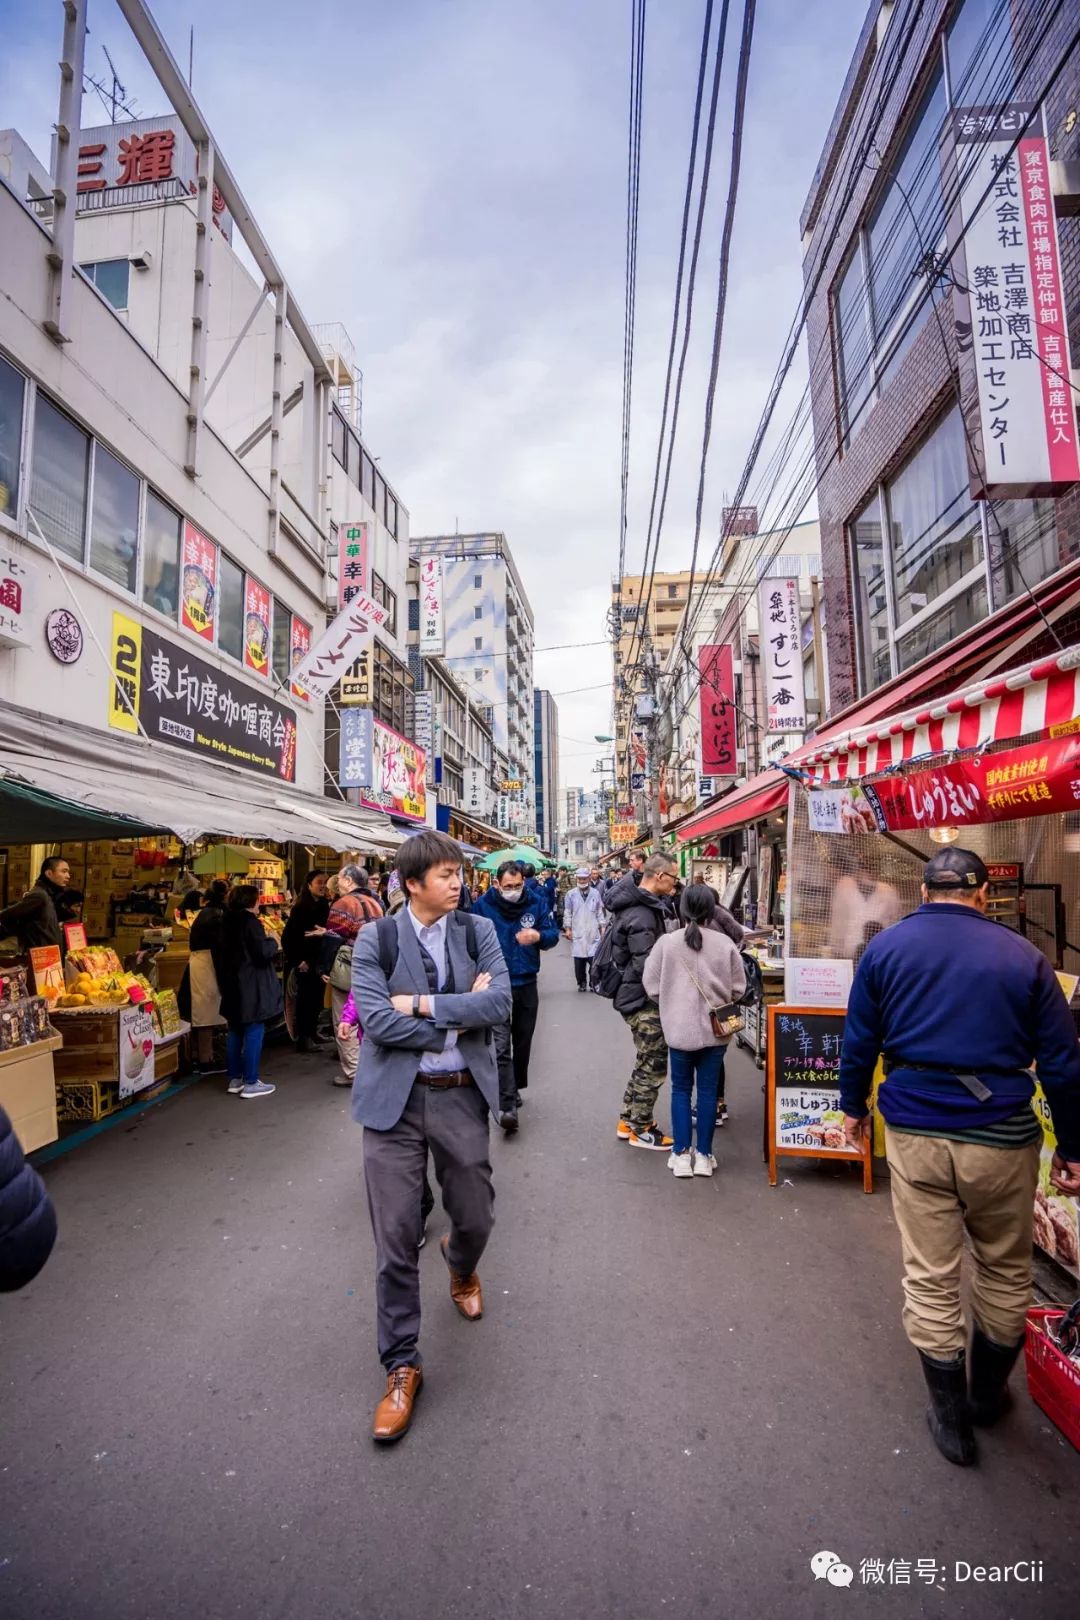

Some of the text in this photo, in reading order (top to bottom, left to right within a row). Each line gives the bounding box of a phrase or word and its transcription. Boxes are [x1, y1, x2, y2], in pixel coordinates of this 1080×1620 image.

[989, 153, 1034, 362] 株式会社 吉澤商店
[1023, 150, 1071, 446] 東京食肉市場指定仲卸 吉澤畜産仕入
[973, 265, 1011, 467] 築地加工センター
[114, 634, 138, 716] 2階
[308, 613, 370, 679] ラーメン
[769, 591, 796, 706] 築地 すし一番
[768, 716, 805, 730] 24時間営業
[908, 775, 981, 821] しゅうまい
